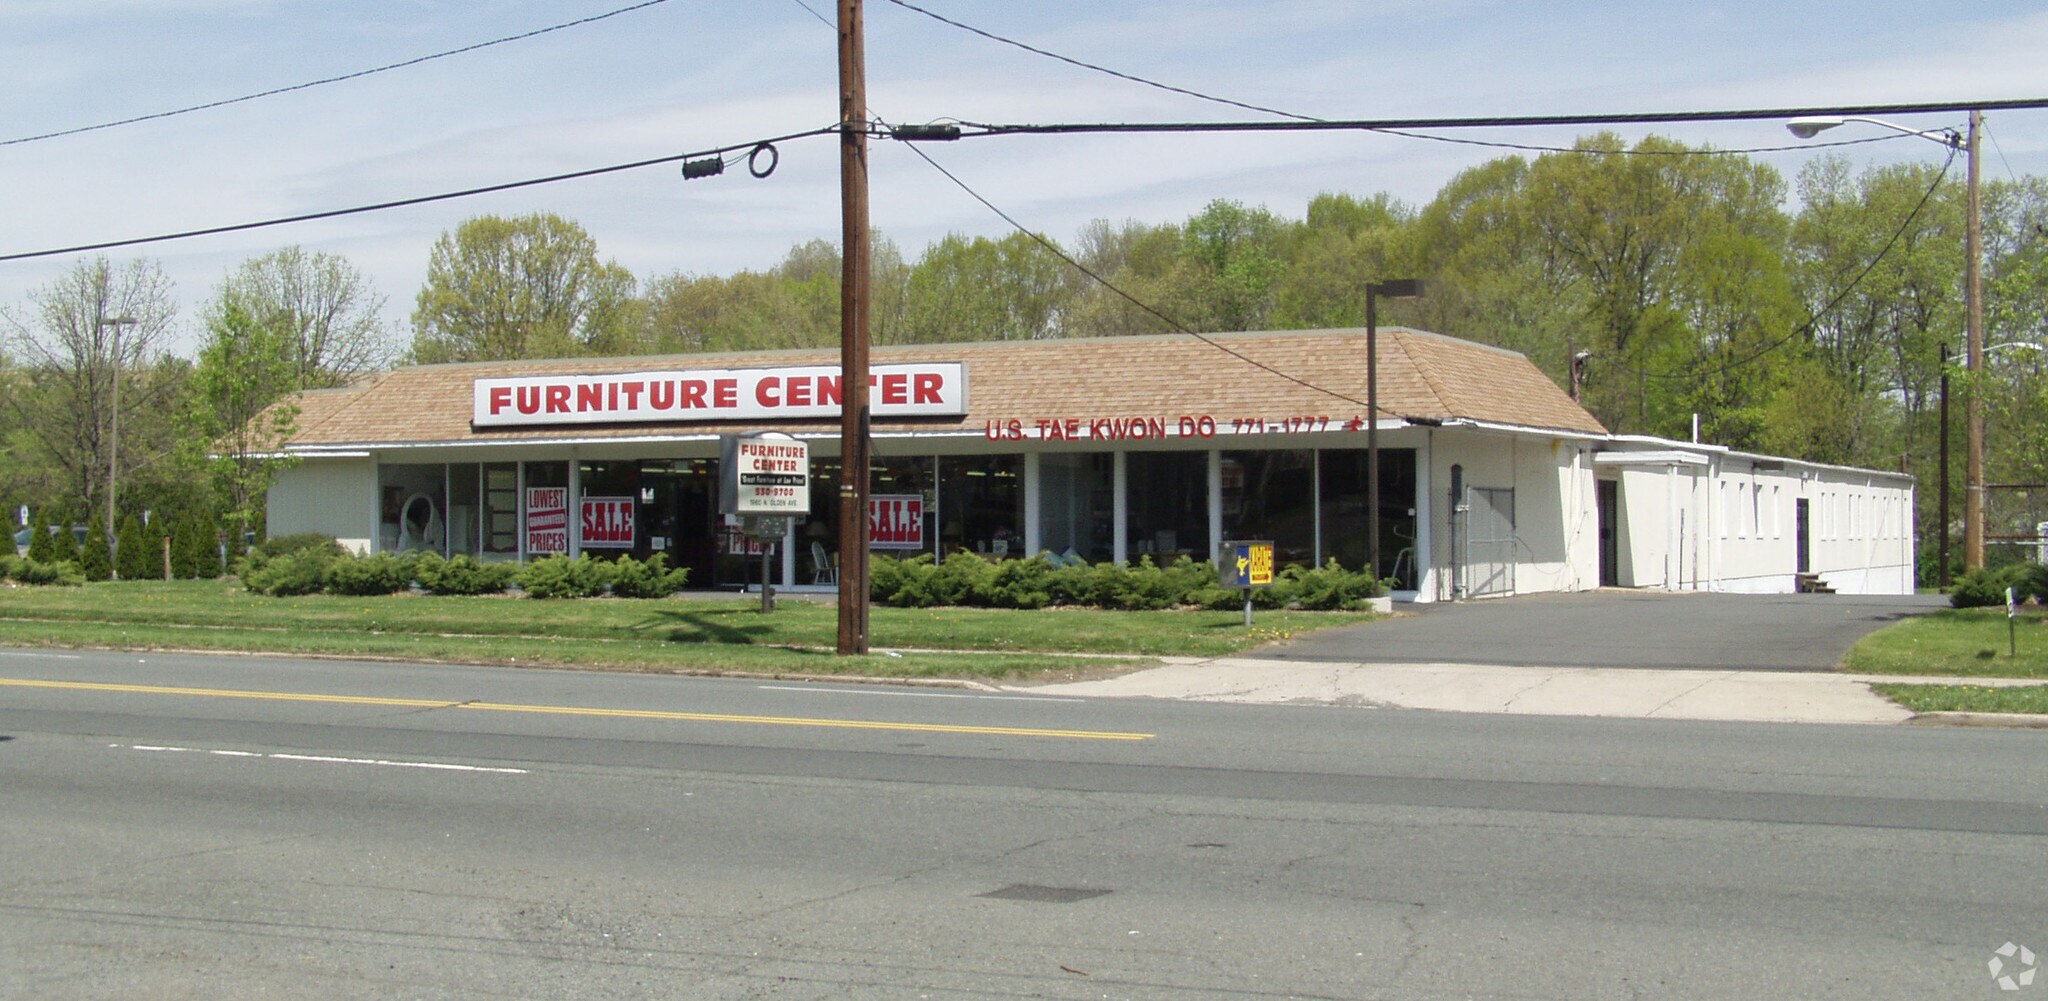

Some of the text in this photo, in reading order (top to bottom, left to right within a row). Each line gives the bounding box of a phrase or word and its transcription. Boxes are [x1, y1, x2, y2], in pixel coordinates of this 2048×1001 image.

[490, 379, 738, 415] FURNITURE
[985, 415, 1330, 442] U.S. TAE KWON DO 771-1777
[741, 444, 805, 458] FURNITURE
[753, 459, 797, 471] CENTER
[529, 489, 564, 508] LOWEST
[582, 502, 633, 541] SALE
[529, 532, 565, 551] PRICES
